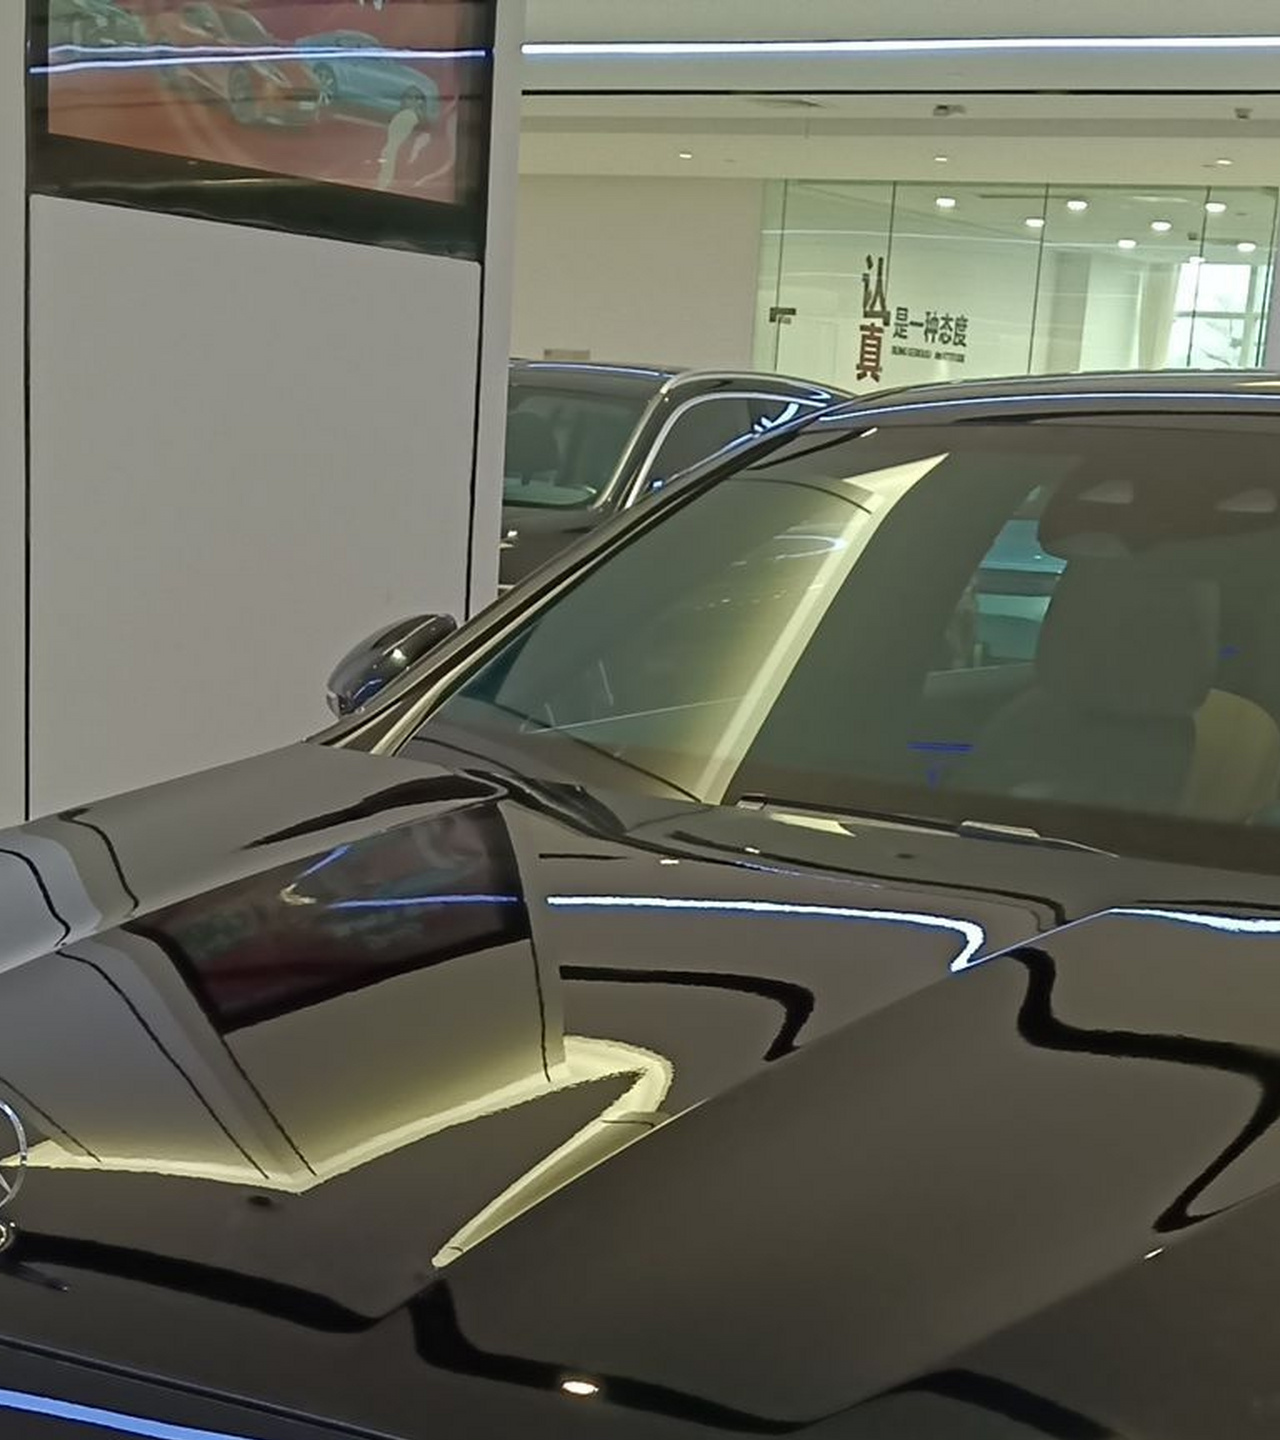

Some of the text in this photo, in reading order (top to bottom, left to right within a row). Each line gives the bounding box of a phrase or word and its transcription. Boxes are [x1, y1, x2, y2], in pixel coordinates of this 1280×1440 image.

[856, 254, 891, 383] 认真
[892, 306, 968, 347] 是一种态度
